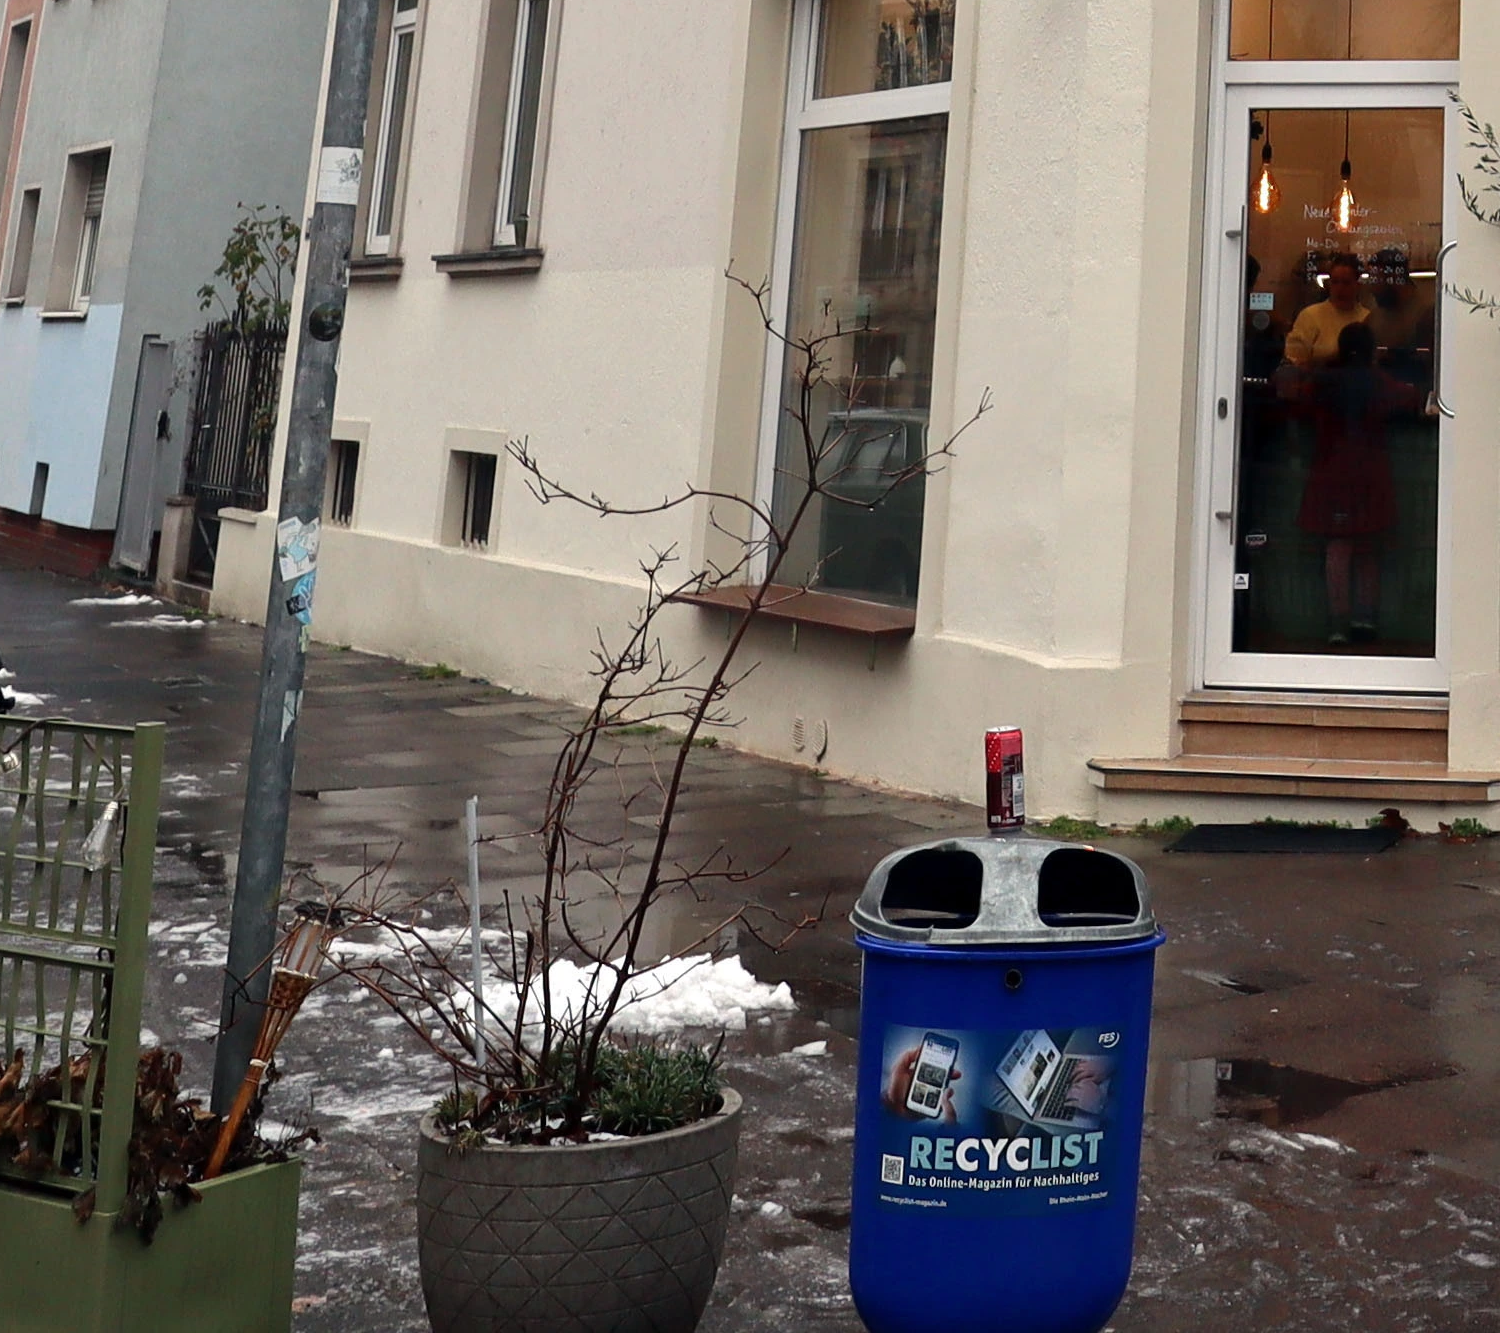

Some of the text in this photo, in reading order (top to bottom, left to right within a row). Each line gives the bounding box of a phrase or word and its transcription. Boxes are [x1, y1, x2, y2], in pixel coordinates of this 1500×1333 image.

[909, 1132, 1104, 1172] RECYCLIST
[908, 1172, 1100, 1192] Das Online-Magazin für Nachhaltiges
